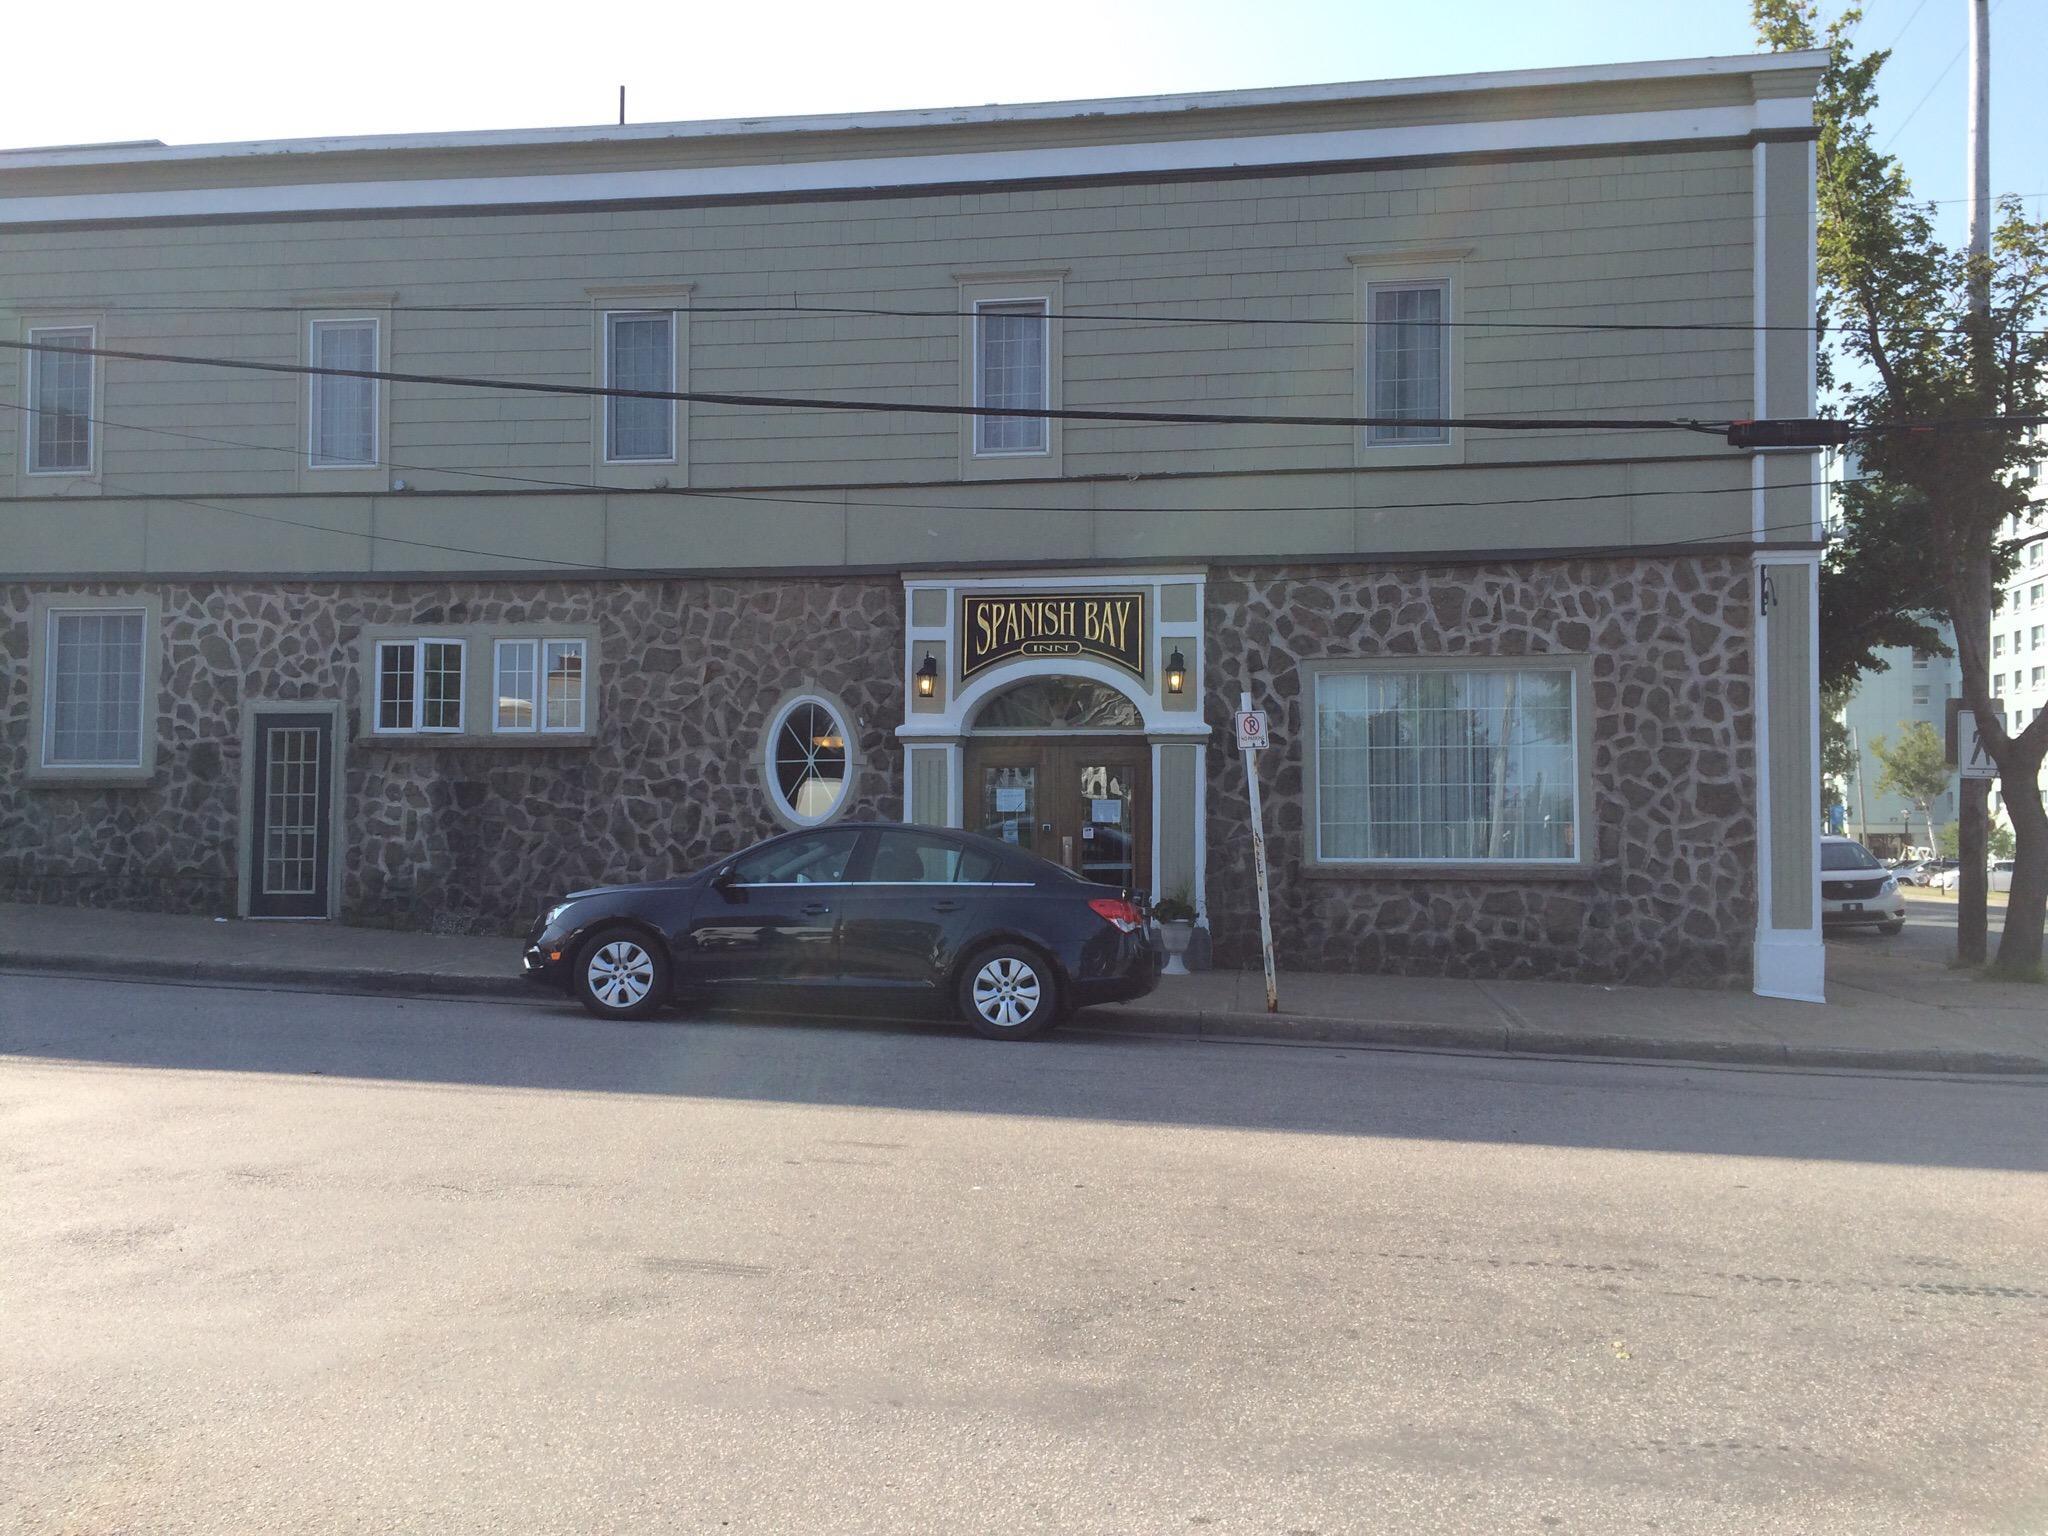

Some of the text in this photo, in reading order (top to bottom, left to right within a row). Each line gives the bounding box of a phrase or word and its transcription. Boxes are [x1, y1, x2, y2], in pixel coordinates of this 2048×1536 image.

[976, 601, 1130, 655] SPANISH BAY
[1033, 644, 1070, 652] INN
